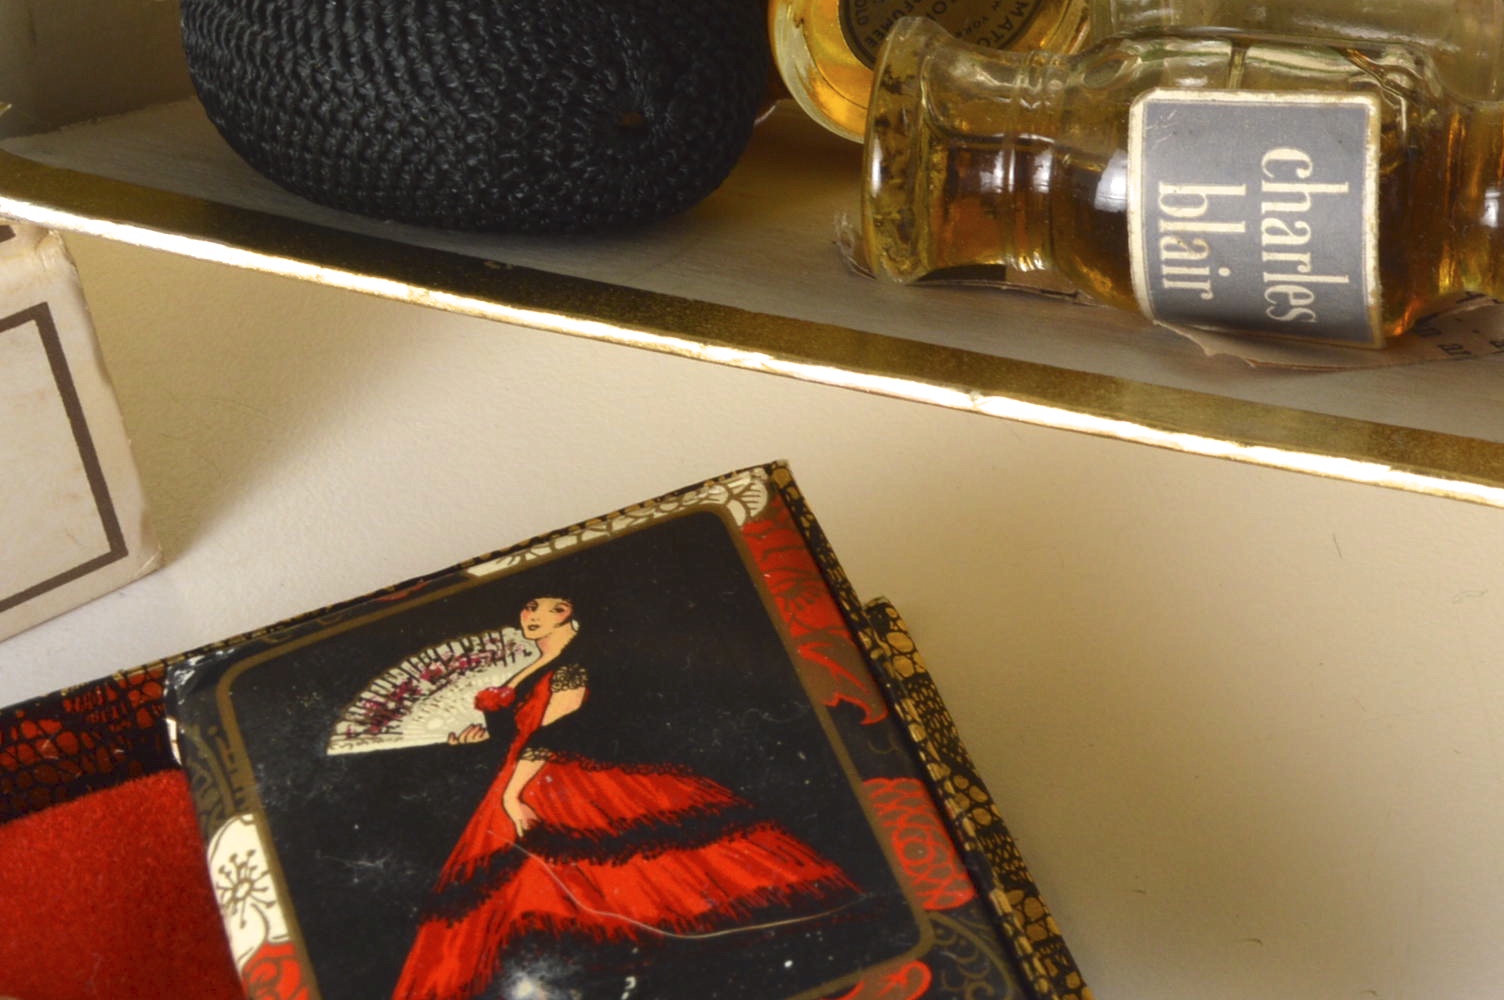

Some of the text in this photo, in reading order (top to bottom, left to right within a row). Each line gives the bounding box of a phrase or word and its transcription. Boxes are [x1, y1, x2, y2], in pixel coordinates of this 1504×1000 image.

[976, 1, 1029, 48] MATC
[1158, 180, 1247, 300] blair
[1260, 147, 1350, 324] charles
